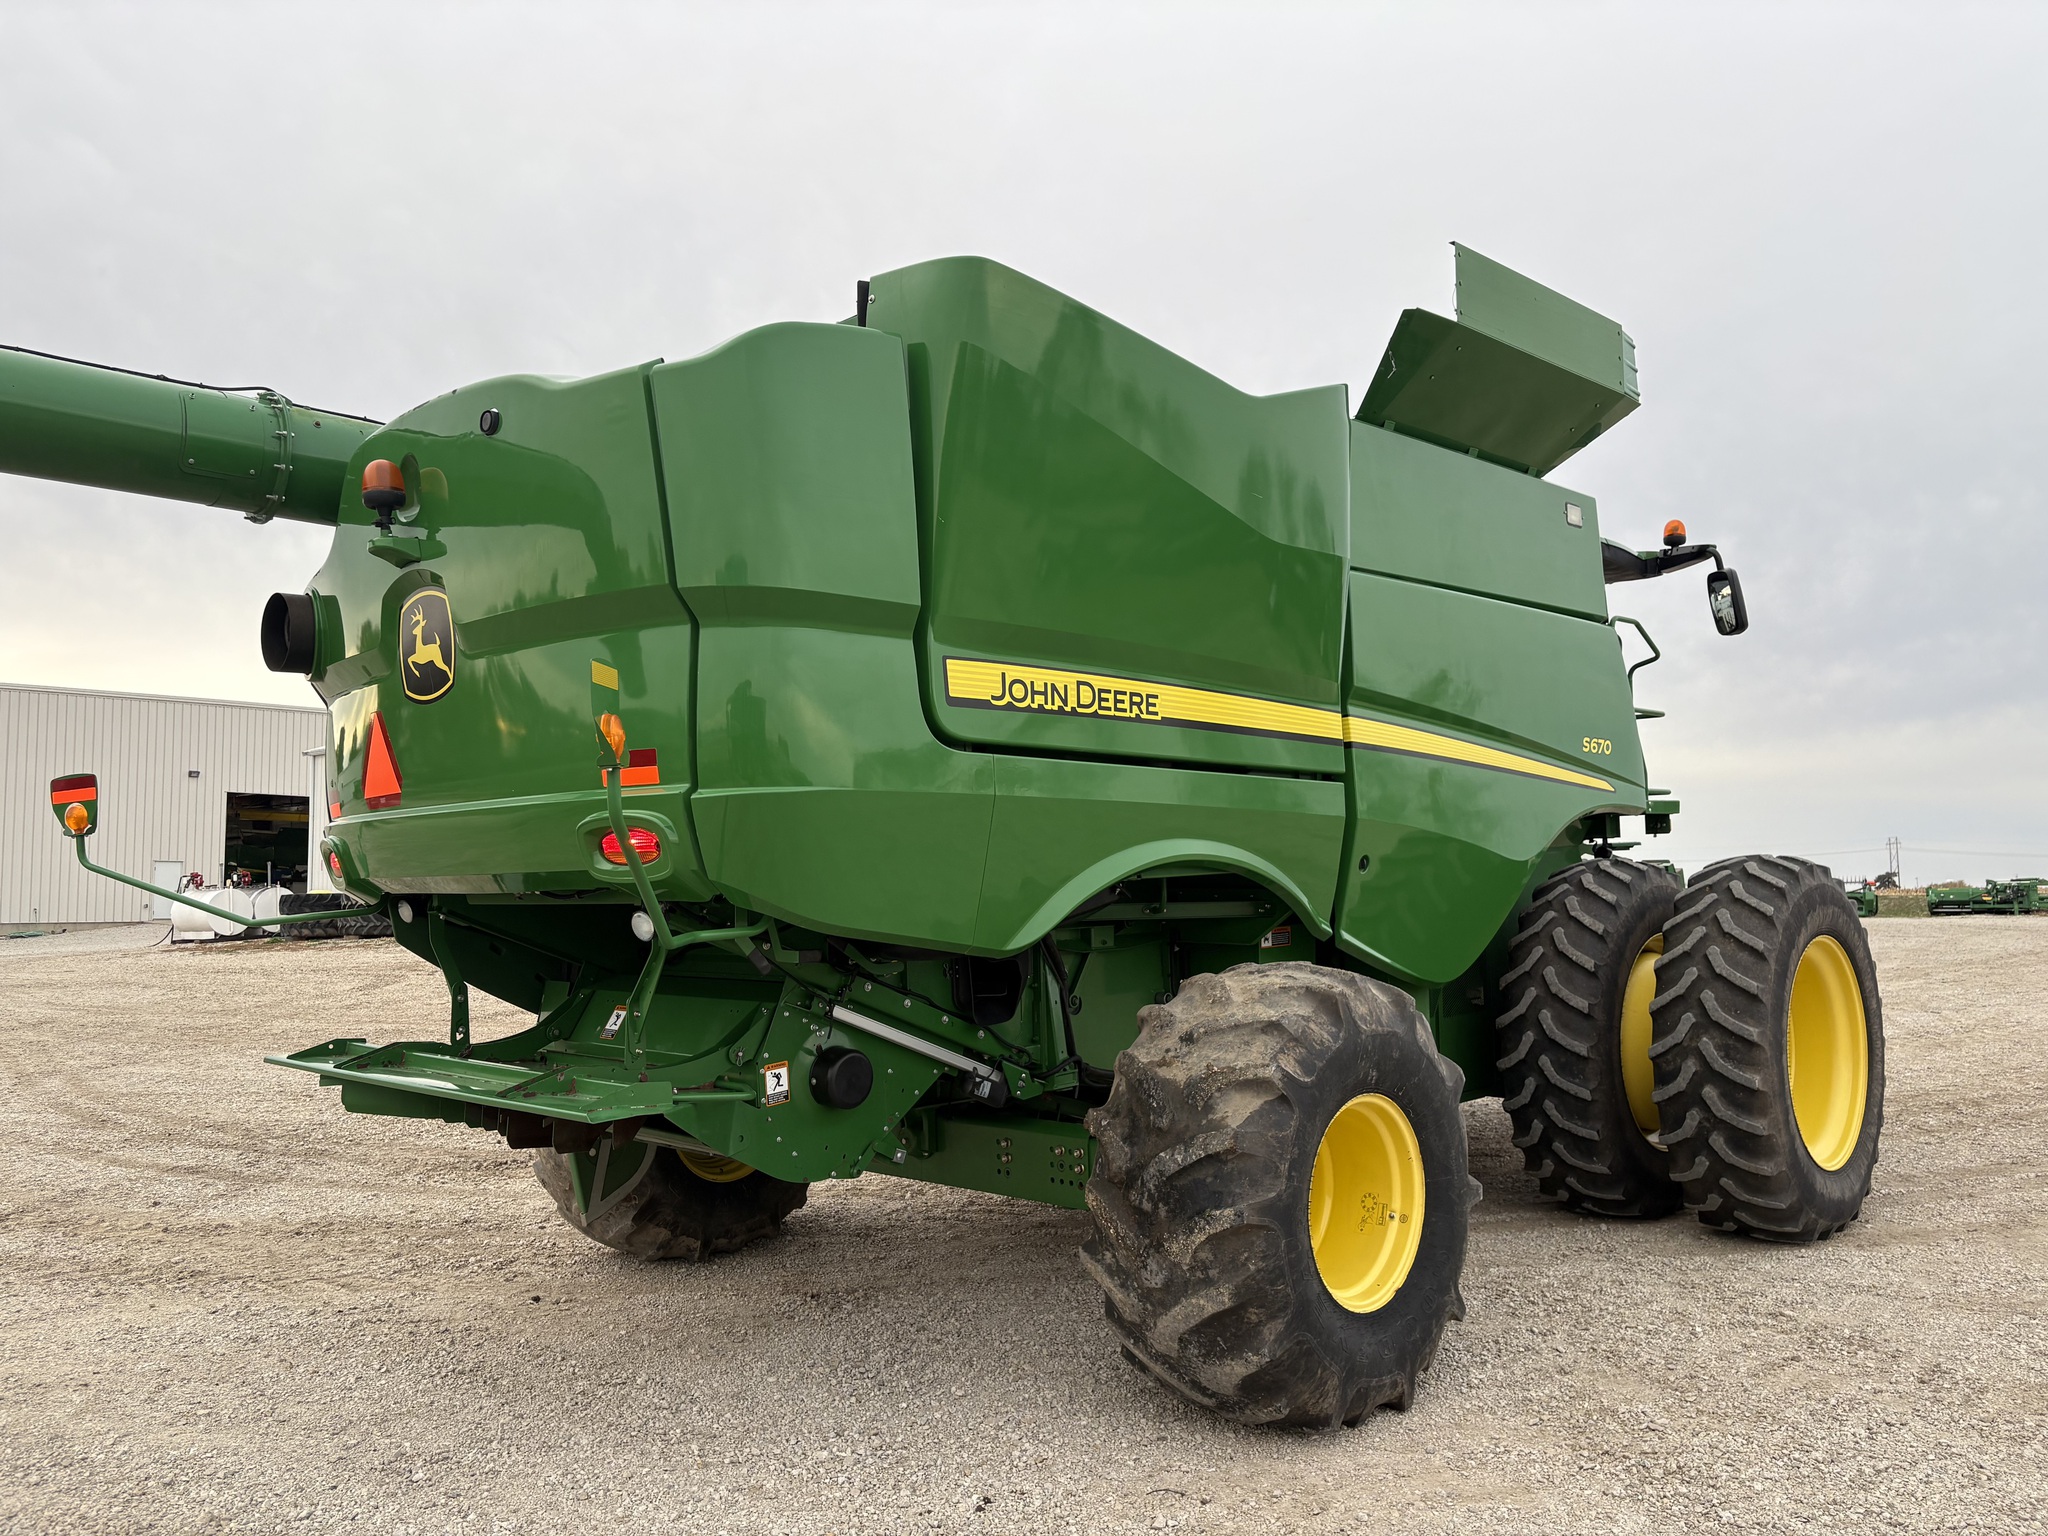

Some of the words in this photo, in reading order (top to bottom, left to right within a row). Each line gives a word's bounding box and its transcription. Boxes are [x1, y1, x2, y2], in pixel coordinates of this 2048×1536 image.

[990, 671, 1069, 709] JOHN
[1075, 679, 1160, 718] DEERE
[1582, 736, 1612, 755] S670
